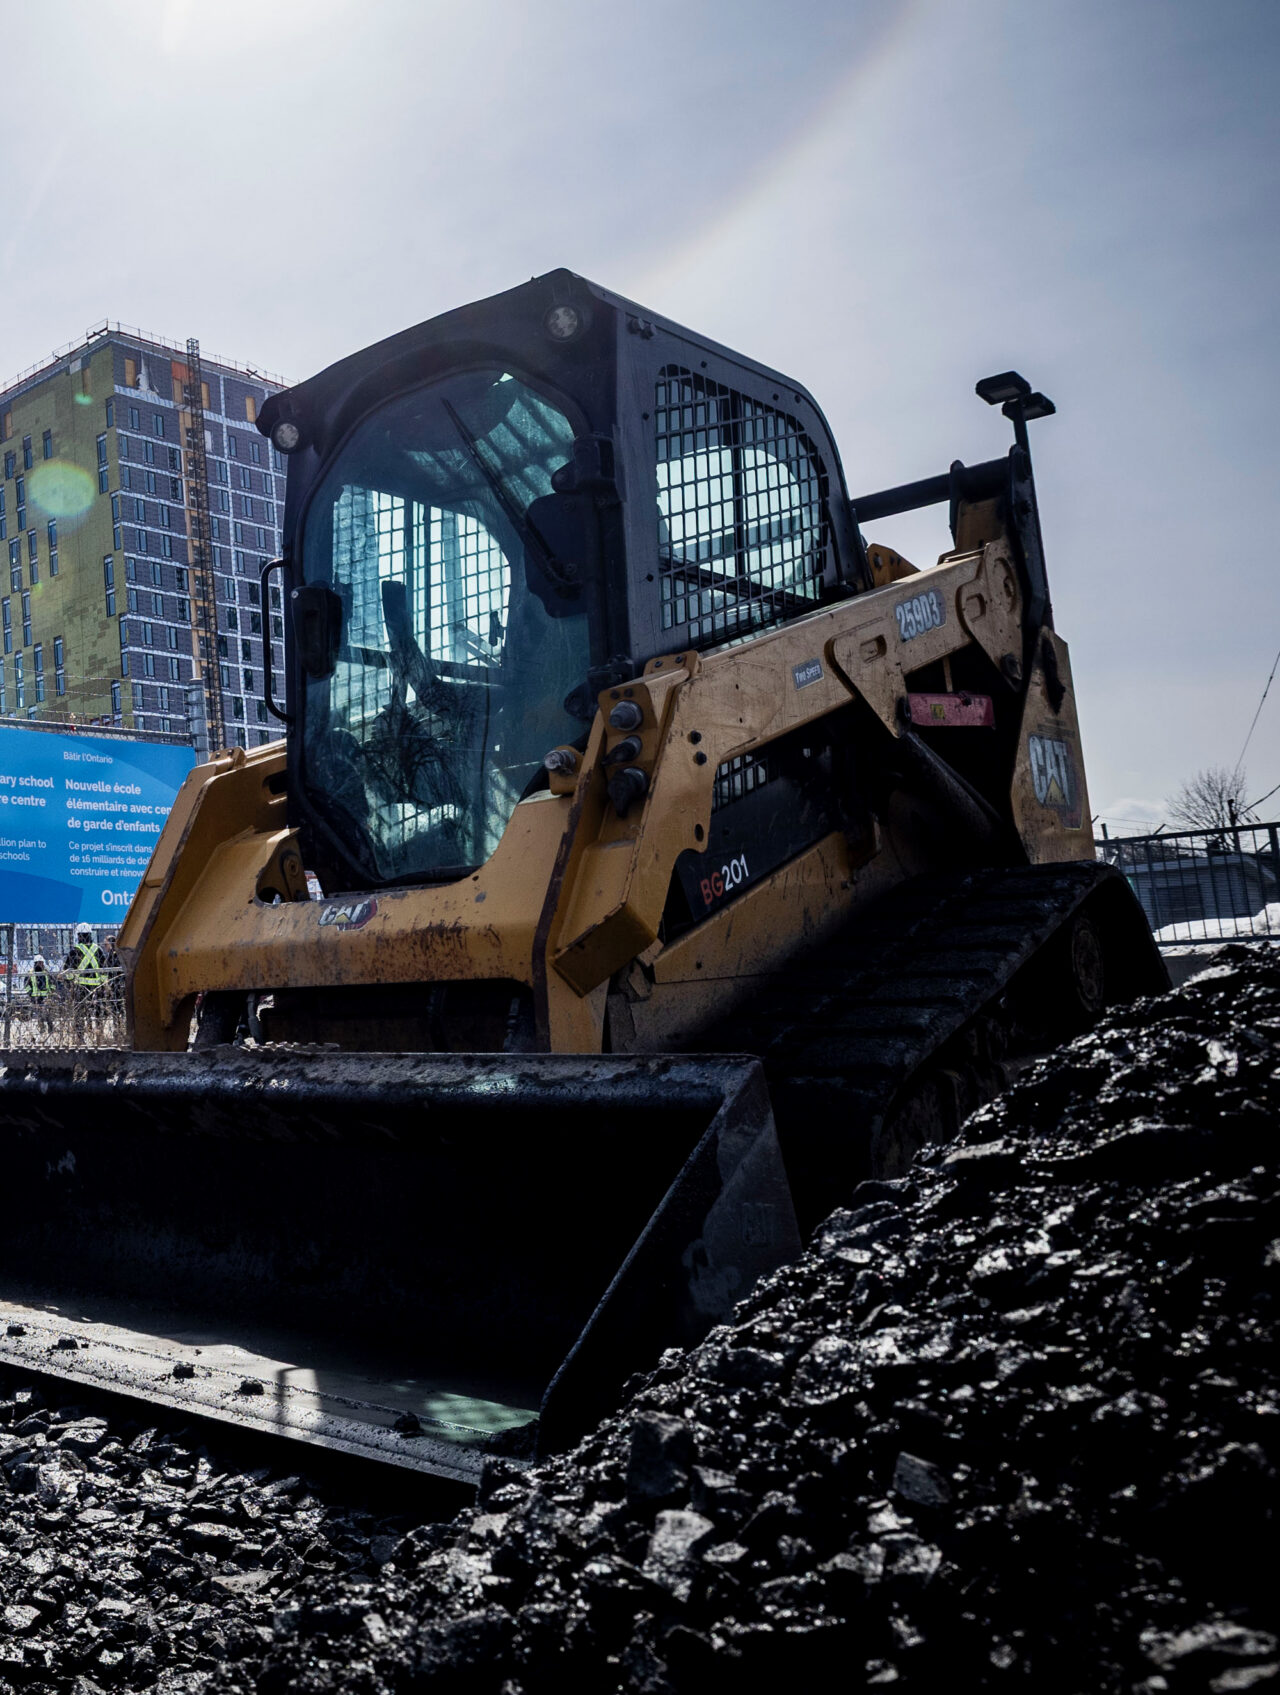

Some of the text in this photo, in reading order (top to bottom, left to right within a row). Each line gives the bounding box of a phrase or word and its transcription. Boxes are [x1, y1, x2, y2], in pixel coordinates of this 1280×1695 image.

[896, 592, 941, 639] 259D3
[63, 751, 114, 764] Bâtir l'Ontario
[1028, 735, 1070, 806] CAT
[18, 776, 55, 789] school
[65, 779, 142, 795] Nouvelle école
[10, 795, 46, 807] centre
[66, 798, 128, 813] élémentaire
[130, 804, 153, 814] avec
[67, 817, 160, 833] de garde d'enfants
[18, 839, 37, 850] plan
[38, 840, 47, 849] to
[68, 841, 153, 854] Ce projet s'inscrit dans
[69, 854, 80, 864] de
[81, 855, 91, 864] 16
[92, 854, 125, 865] milliards
[126, 856, 136, 865] de
[70, 867, 109, 877] construire
[110, 868, 119, 877] et
[700, 853, 749, 905] BG201
